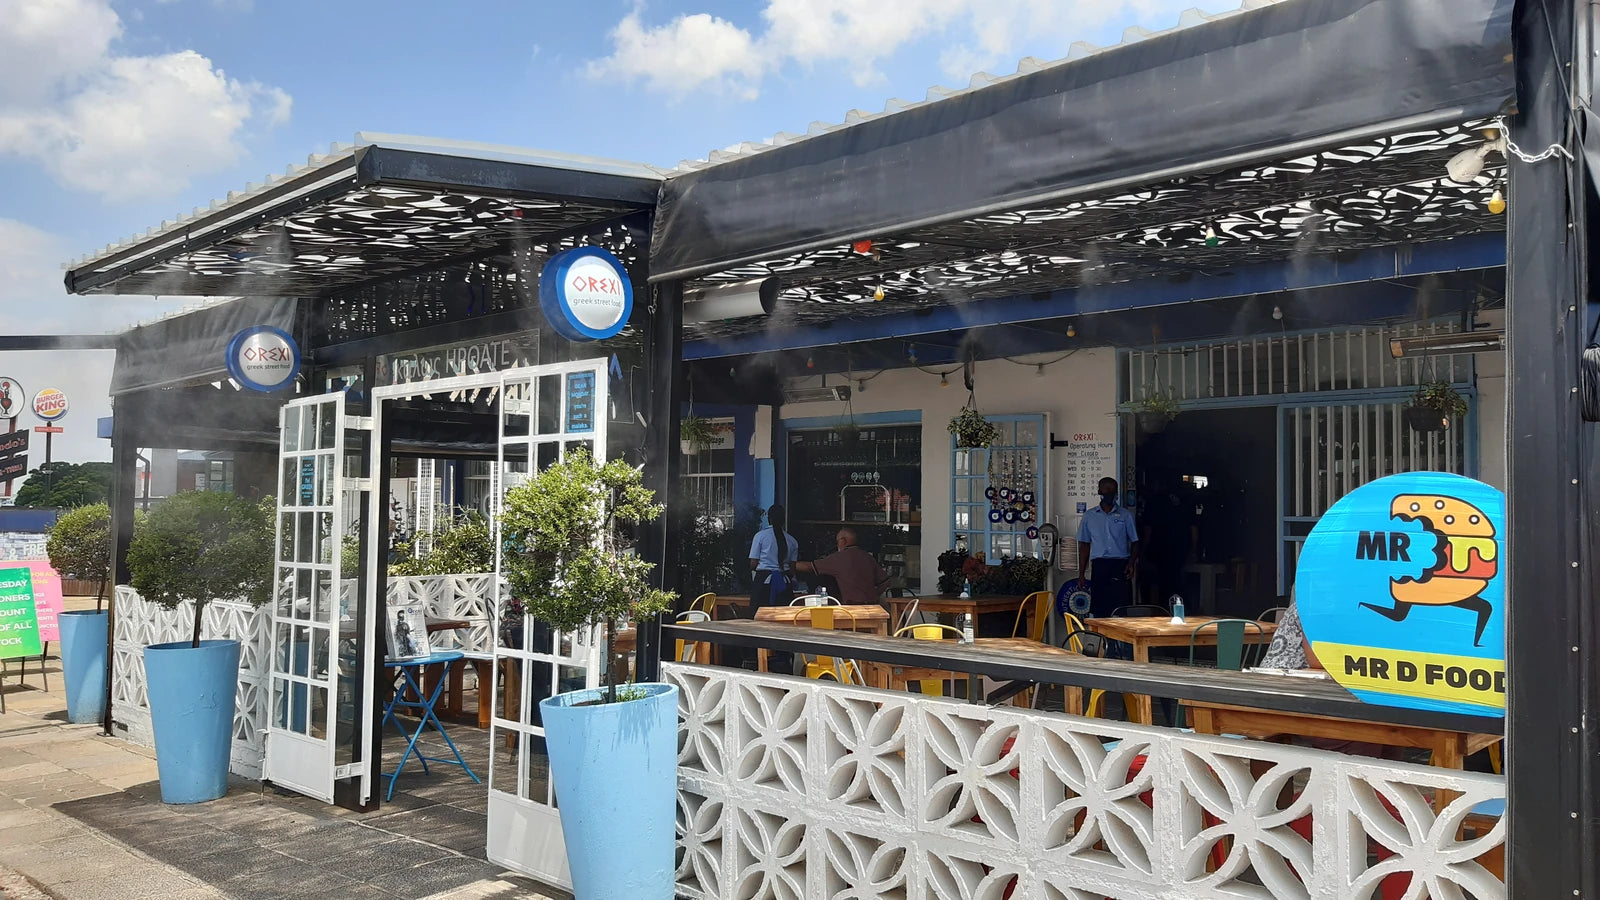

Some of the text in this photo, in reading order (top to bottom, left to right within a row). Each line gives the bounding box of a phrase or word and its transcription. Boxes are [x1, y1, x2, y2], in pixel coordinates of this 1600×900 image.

[572, 276, 621, 296] OREXI
[573, 298, 592, 306] greek
[594, 298, 611, 306] street
[244, 347, 290, 361] OREXI
[36, 393, 64, 404] BURGER
[36, 400, 66, 413] KING
[1073, 433, 1094, 441] OREXI
[1355, 530, 1411, 562] MR
[14, 620, 33, 631] ALL
[0, 636, 22, 646] OCK
[1344, 655, 1390, 680] MR
[1397, 661, 1418, 682] D
